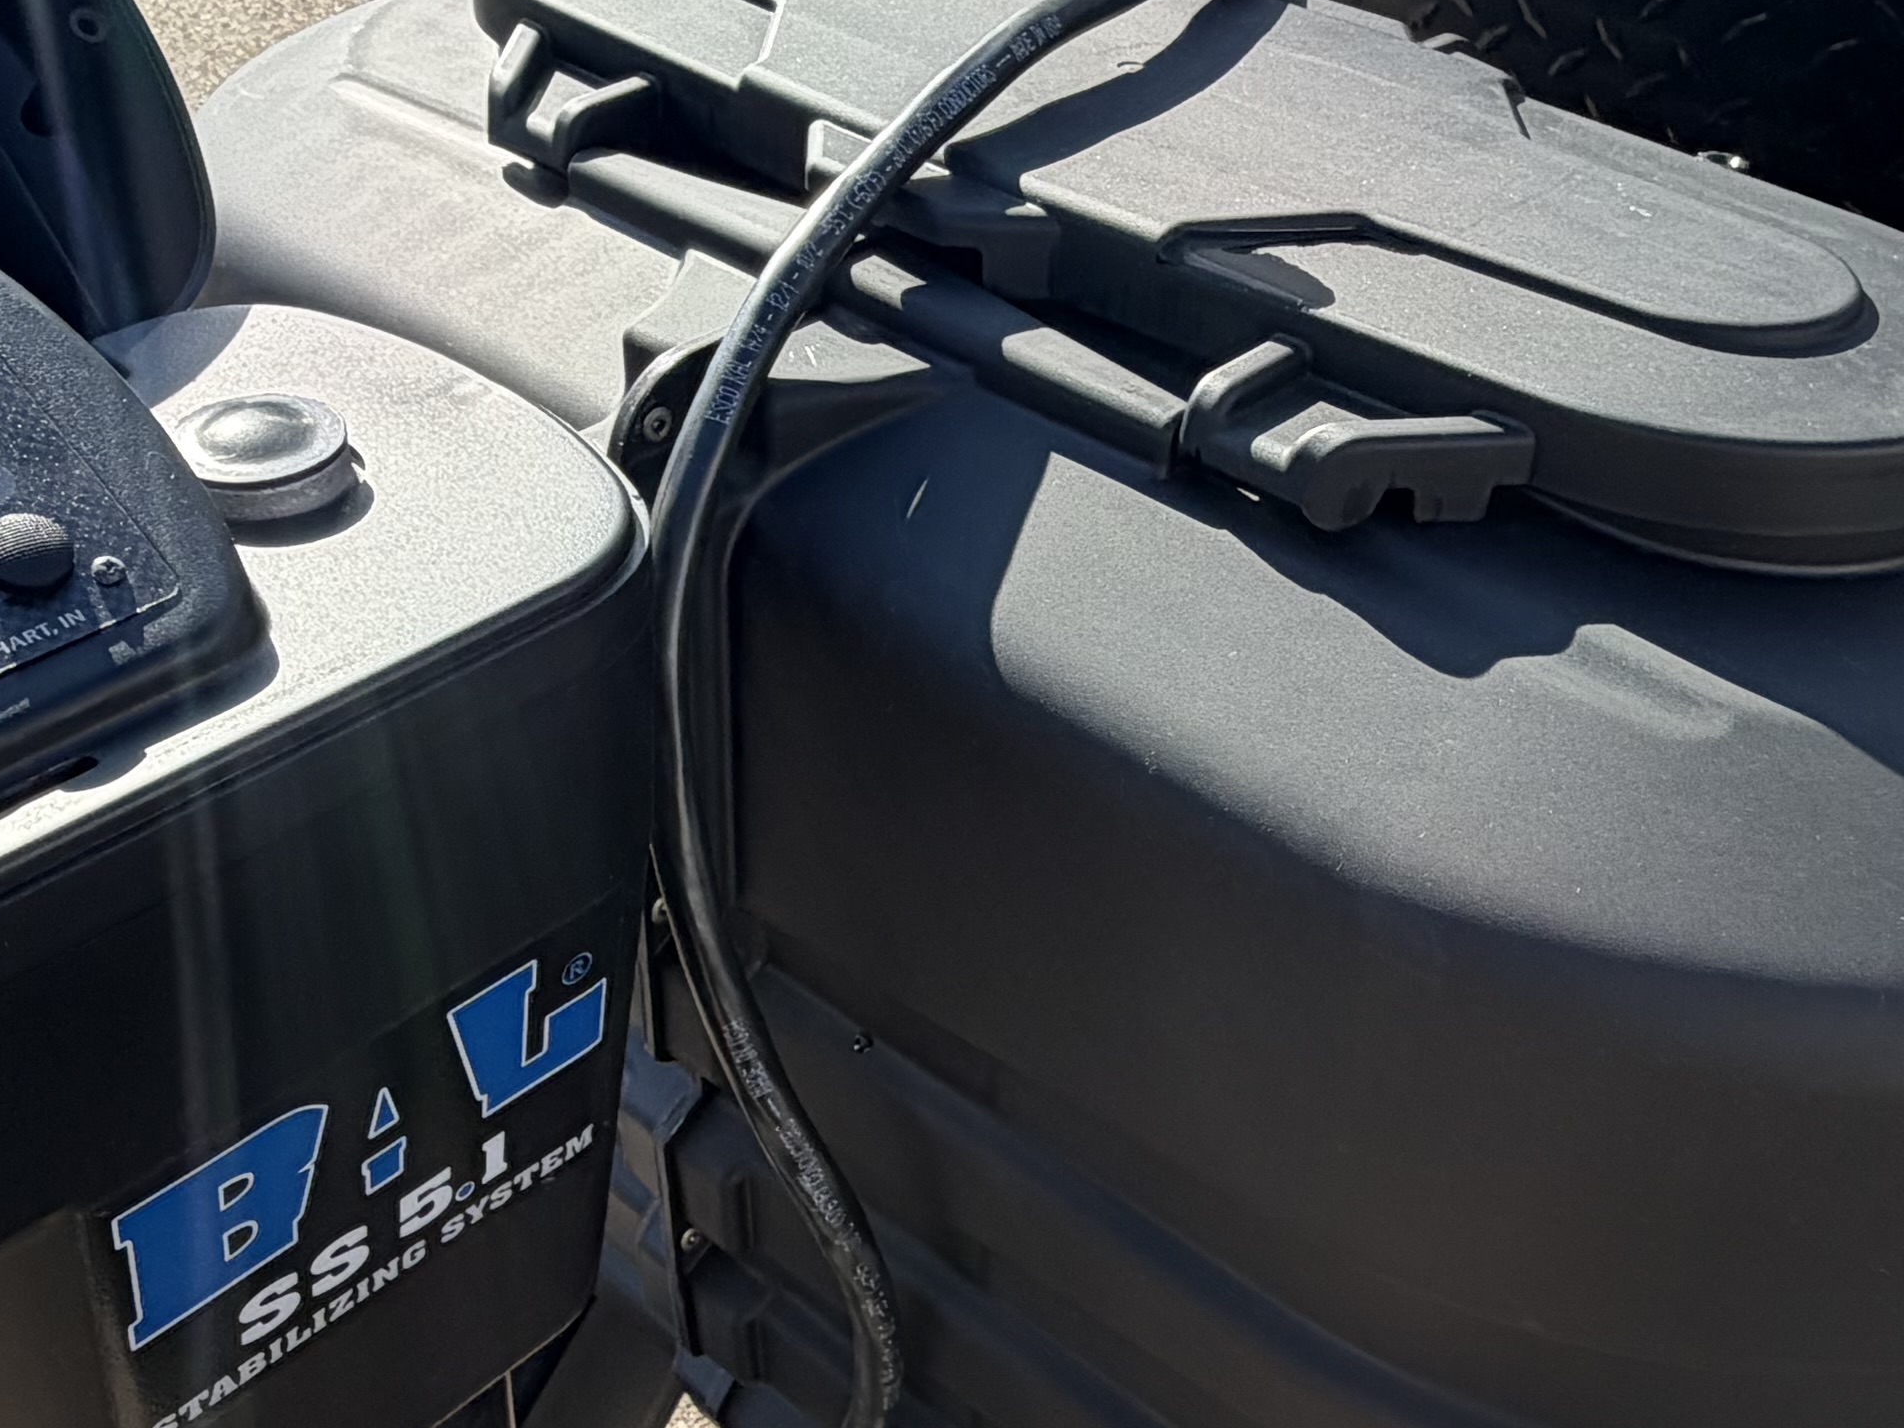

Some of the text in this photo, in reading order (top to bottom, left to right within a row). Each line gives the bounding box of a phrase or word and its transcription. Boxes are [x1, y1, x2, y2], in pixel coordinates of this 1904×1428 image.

[59, 608, 87, 629] IN
[239, 1131, 509, 1348] SS 5.1
[441, 1123, 595, 1245] SYSTEM
